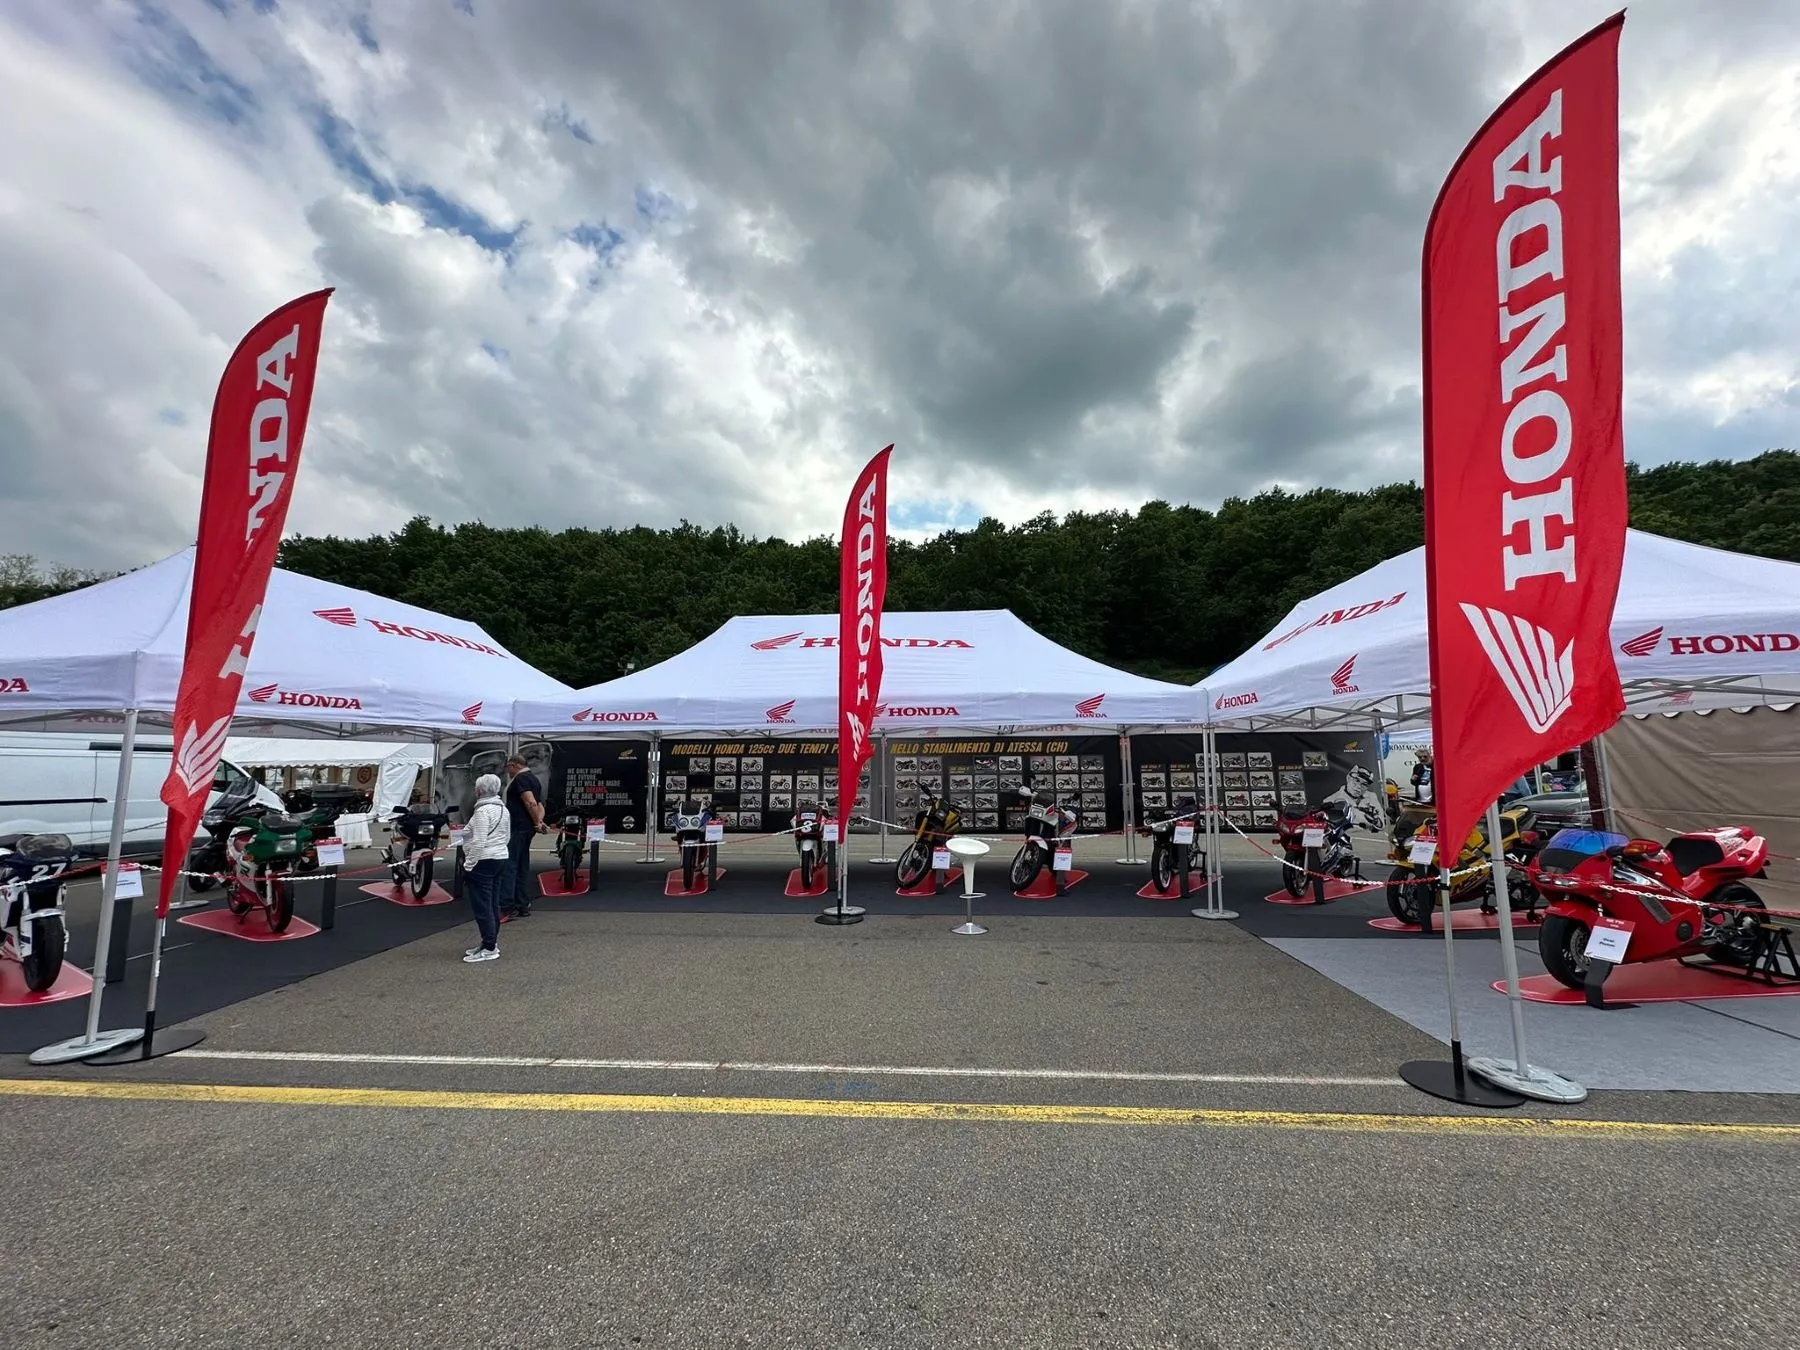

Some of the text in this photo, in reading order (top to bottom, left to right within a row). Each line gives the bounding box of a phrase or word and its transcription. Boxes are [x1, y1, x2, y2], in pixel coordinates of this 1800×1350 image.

[1493, 88, 1577, 591] HONDA
[364, 618, 509, 659] HONDA
[800, 637, 975, 649] HNDA
[1332, 685, 1360, 696] HONDA
[278, 692, 362, 710] HONDA
[1224, 692, 1259, 708] HONDA
[592, 711, 659, 722] HONDA
[888, 706, 960, 716] HONDA
[671, 744, 713, 755] MODELLI
[713, 743, 745, 755] HONDA
[748, 743, 775, 754] 125cc
[778, 743, 798, 754] DUE
[799, 743, 829, 754] TEMPI
[891, 742, 1068, 754] NELLO STABILIMENTO DI ATESSA (CH)
[31, 862, 67, 880] 27
